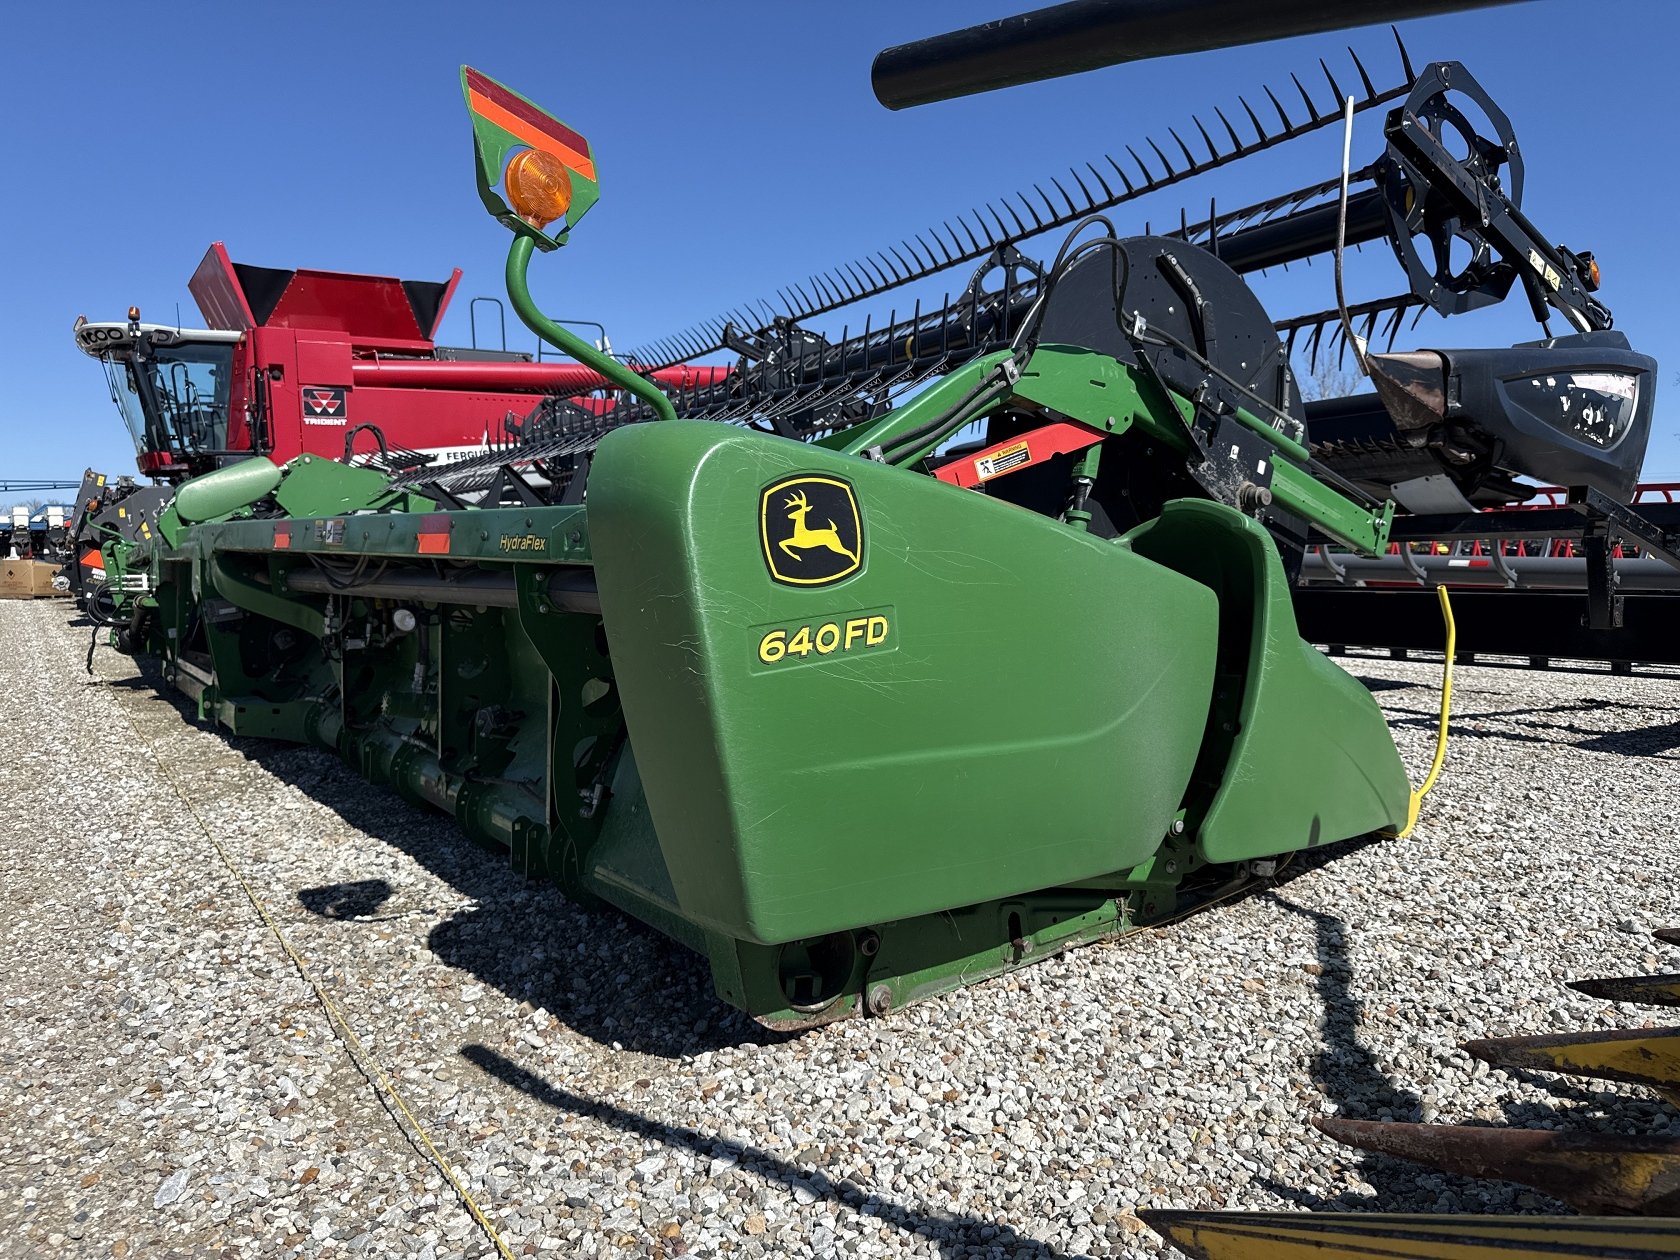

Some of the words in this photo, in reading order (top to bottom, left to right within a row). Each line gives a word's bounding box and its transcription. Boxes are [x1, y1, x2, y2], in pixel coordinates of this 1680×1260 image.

[303, 418, 347, 426] TRIDENT
[446, 449, 495, 461] FERGUS
[499, 533, 546, 553] HydraFlex
[758, 622, 840, 665] 640
[843, 614, 889, 652] FD
